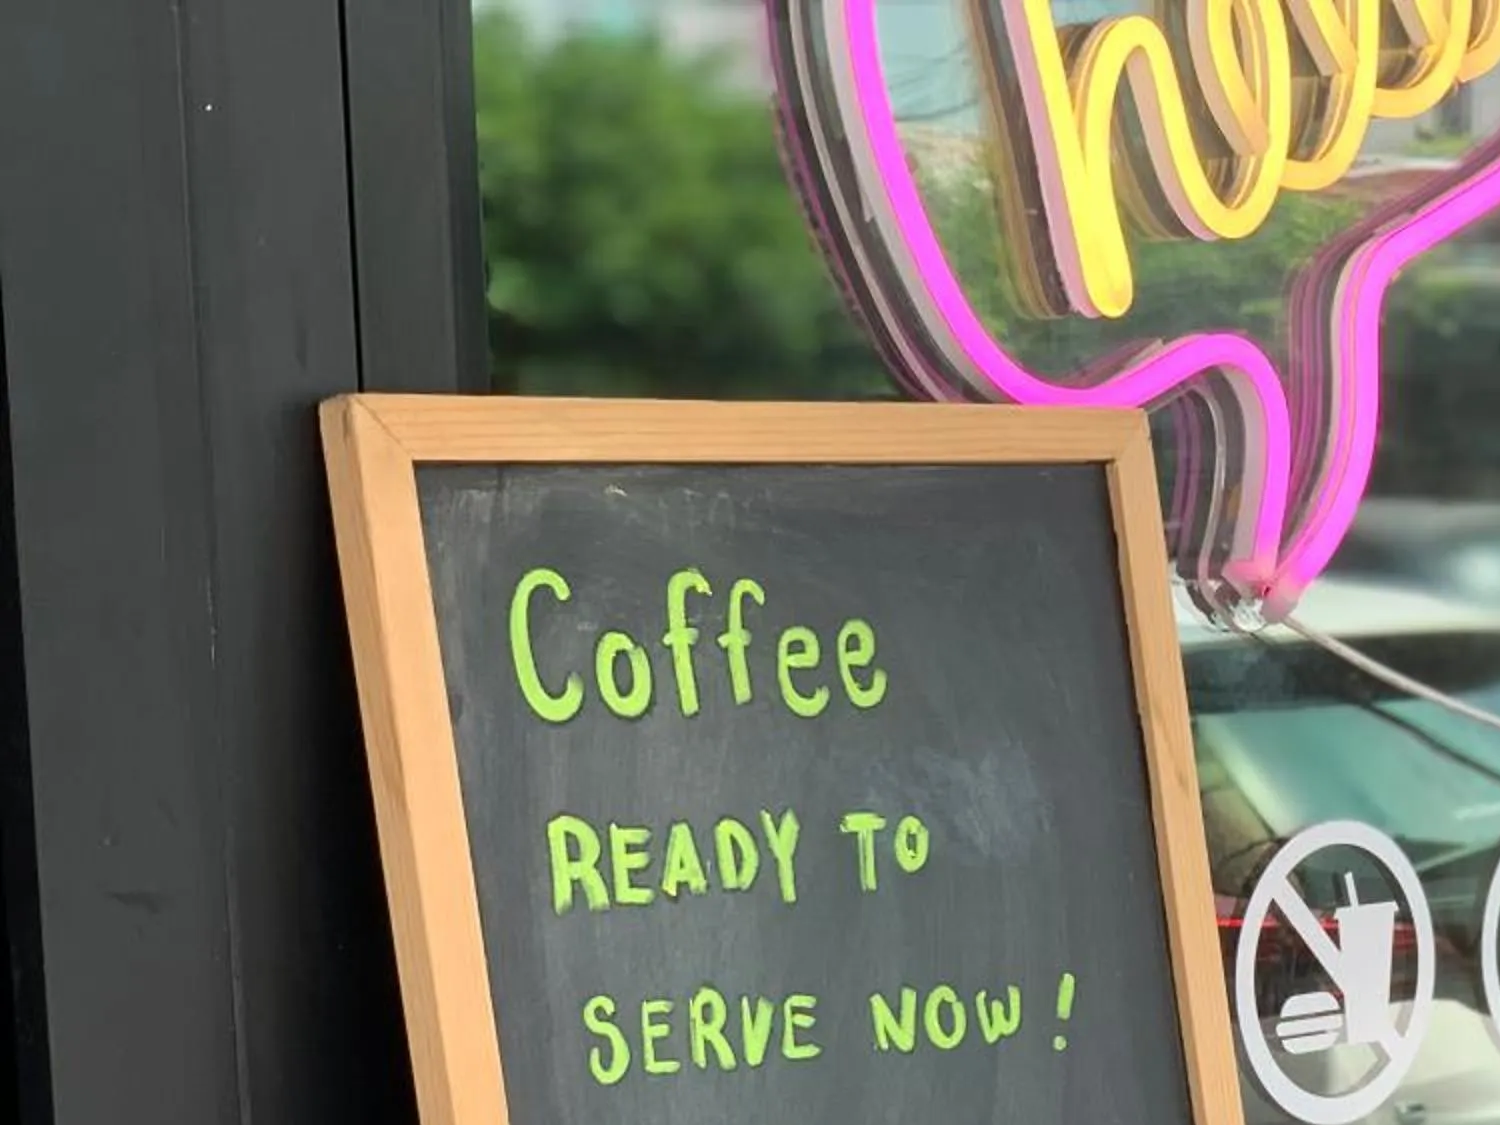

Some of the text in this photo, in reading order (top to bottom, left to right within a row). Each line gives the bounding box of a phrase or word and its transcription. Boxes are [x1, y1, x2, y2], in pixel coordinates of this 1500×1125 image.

[508, 567, 888, 723] Coffee
[546, 808, 930, 915] READY TO
[582, 986, 820, 1085] SERVE
